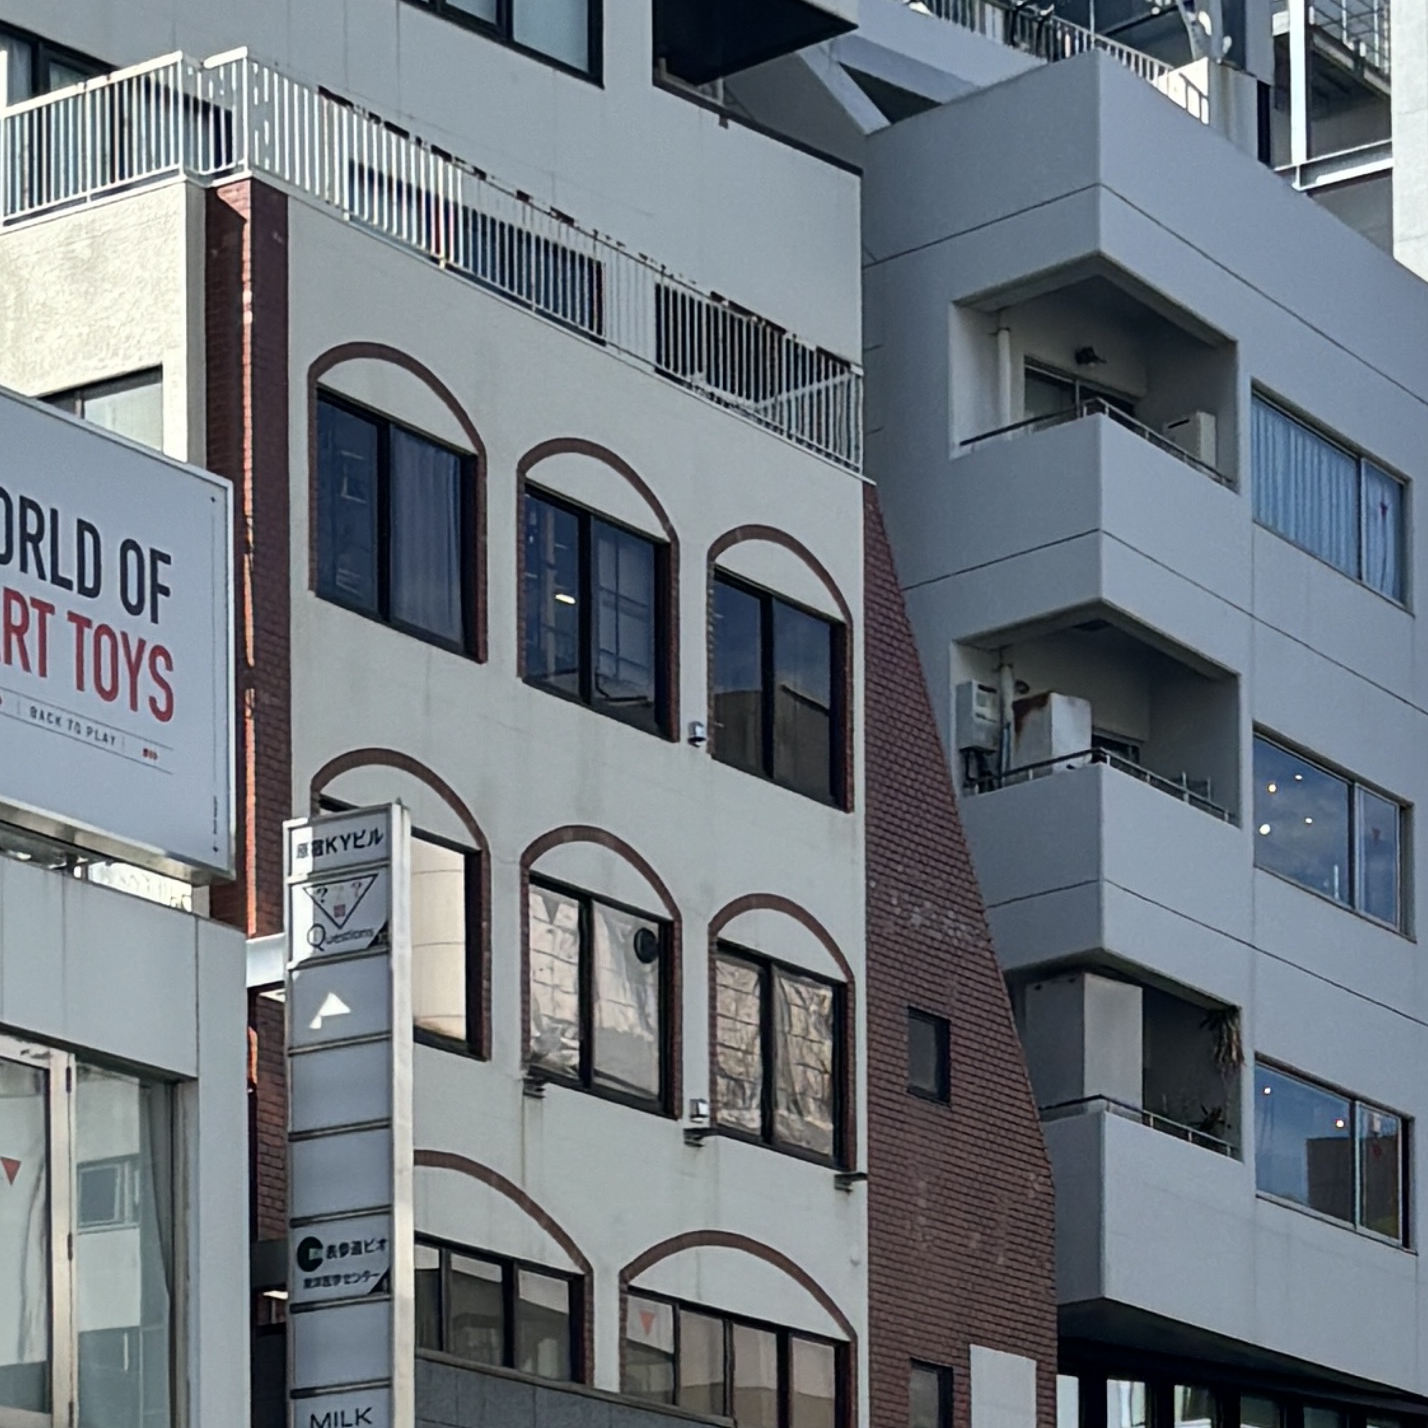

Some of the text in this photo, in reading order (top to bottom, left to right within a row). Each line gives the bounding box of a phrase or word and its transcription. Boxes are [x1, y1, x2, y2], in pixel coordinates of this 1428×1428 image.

[119, 538, 173, 625] OF
[66, 610, 175, 724] TOYS
[29, 705, 116, 746] BACK TO PLAY
